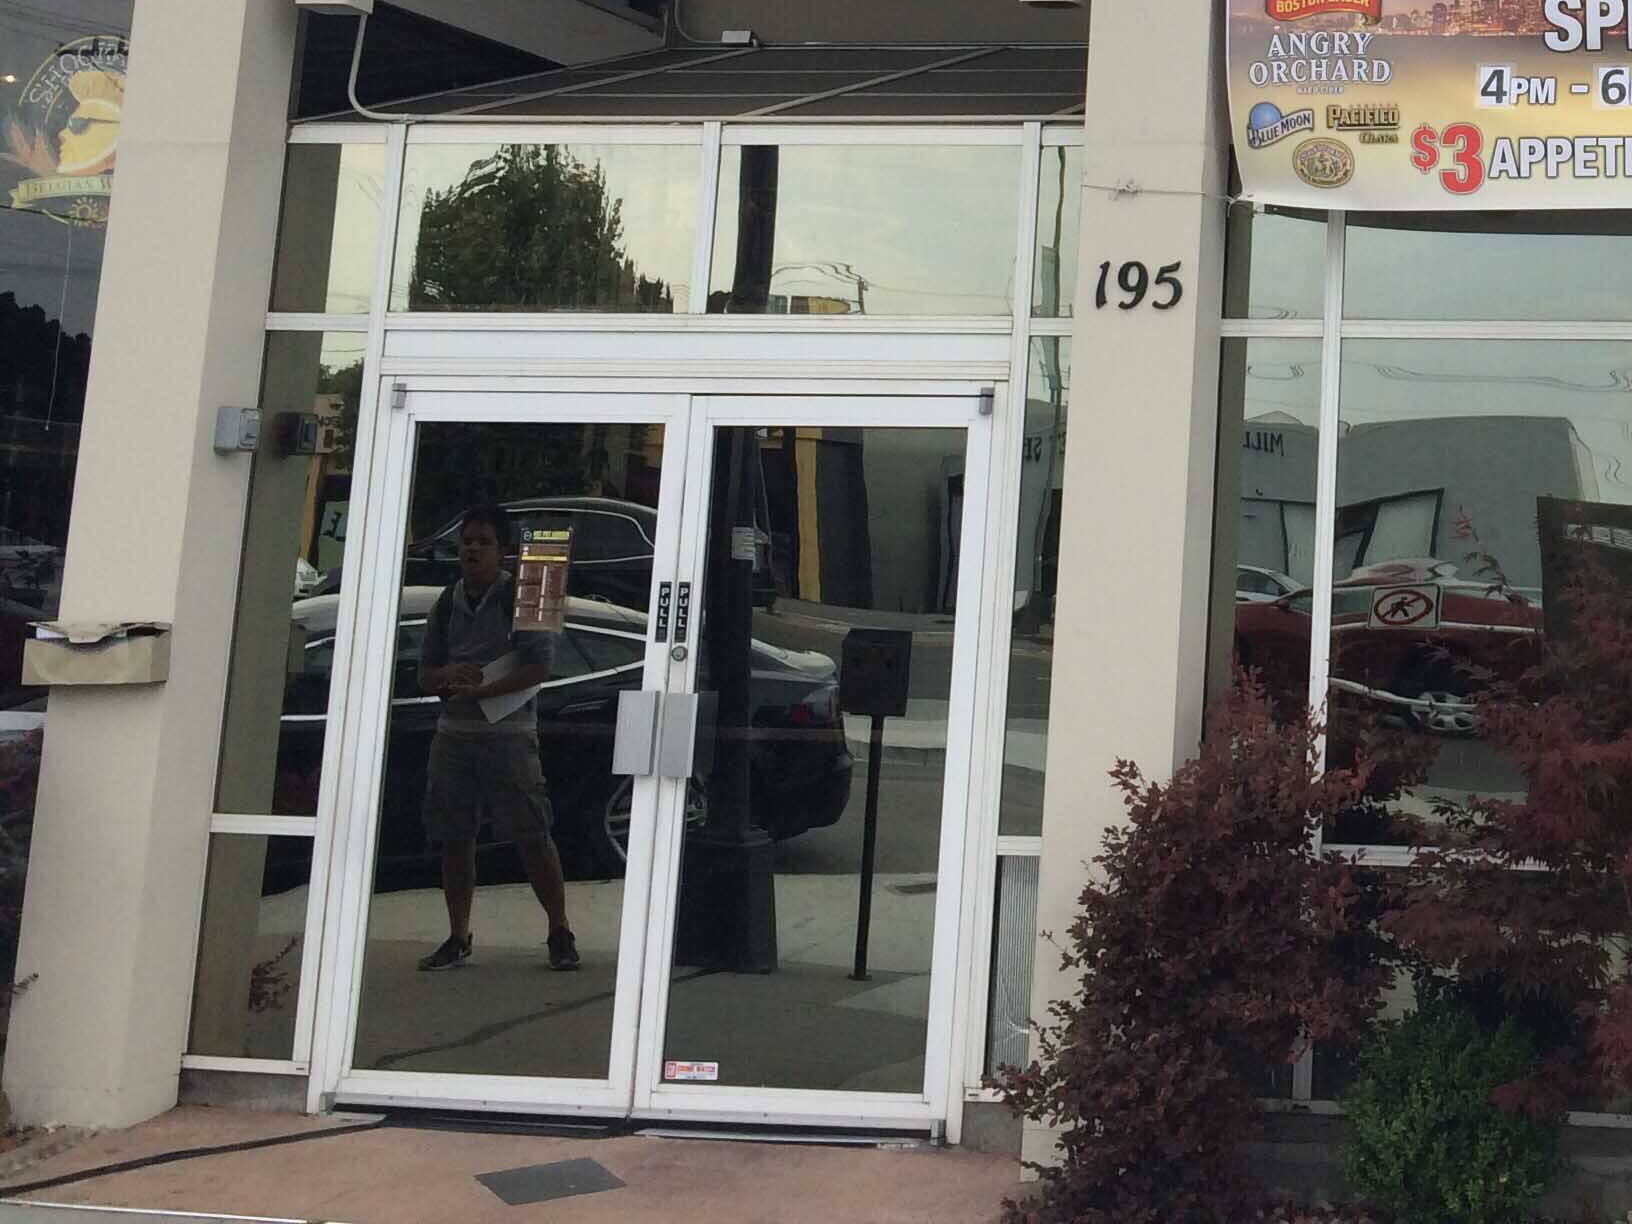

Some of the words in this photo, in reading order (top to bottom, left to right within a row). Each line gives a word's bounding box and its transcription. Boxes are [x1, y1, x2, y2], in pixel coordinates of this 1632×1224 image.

[1267, 32, 1374, 57] ANGRY
[1250, 59, 1392, 85] ORCHARD
[1480, 68, 1556, 105] 4PM
[1250, 127, 1279, 146] BLUE
[1281, 113, 1311, 133] MOON
[1326, 104, 1400, 128] PACIFICO
[1411, 122, 1487, 195] $3
[1095, 261, 1183, 310] 195
[659, 587, 670, 627] PULL
[678, 587, 689, 627] PULL
